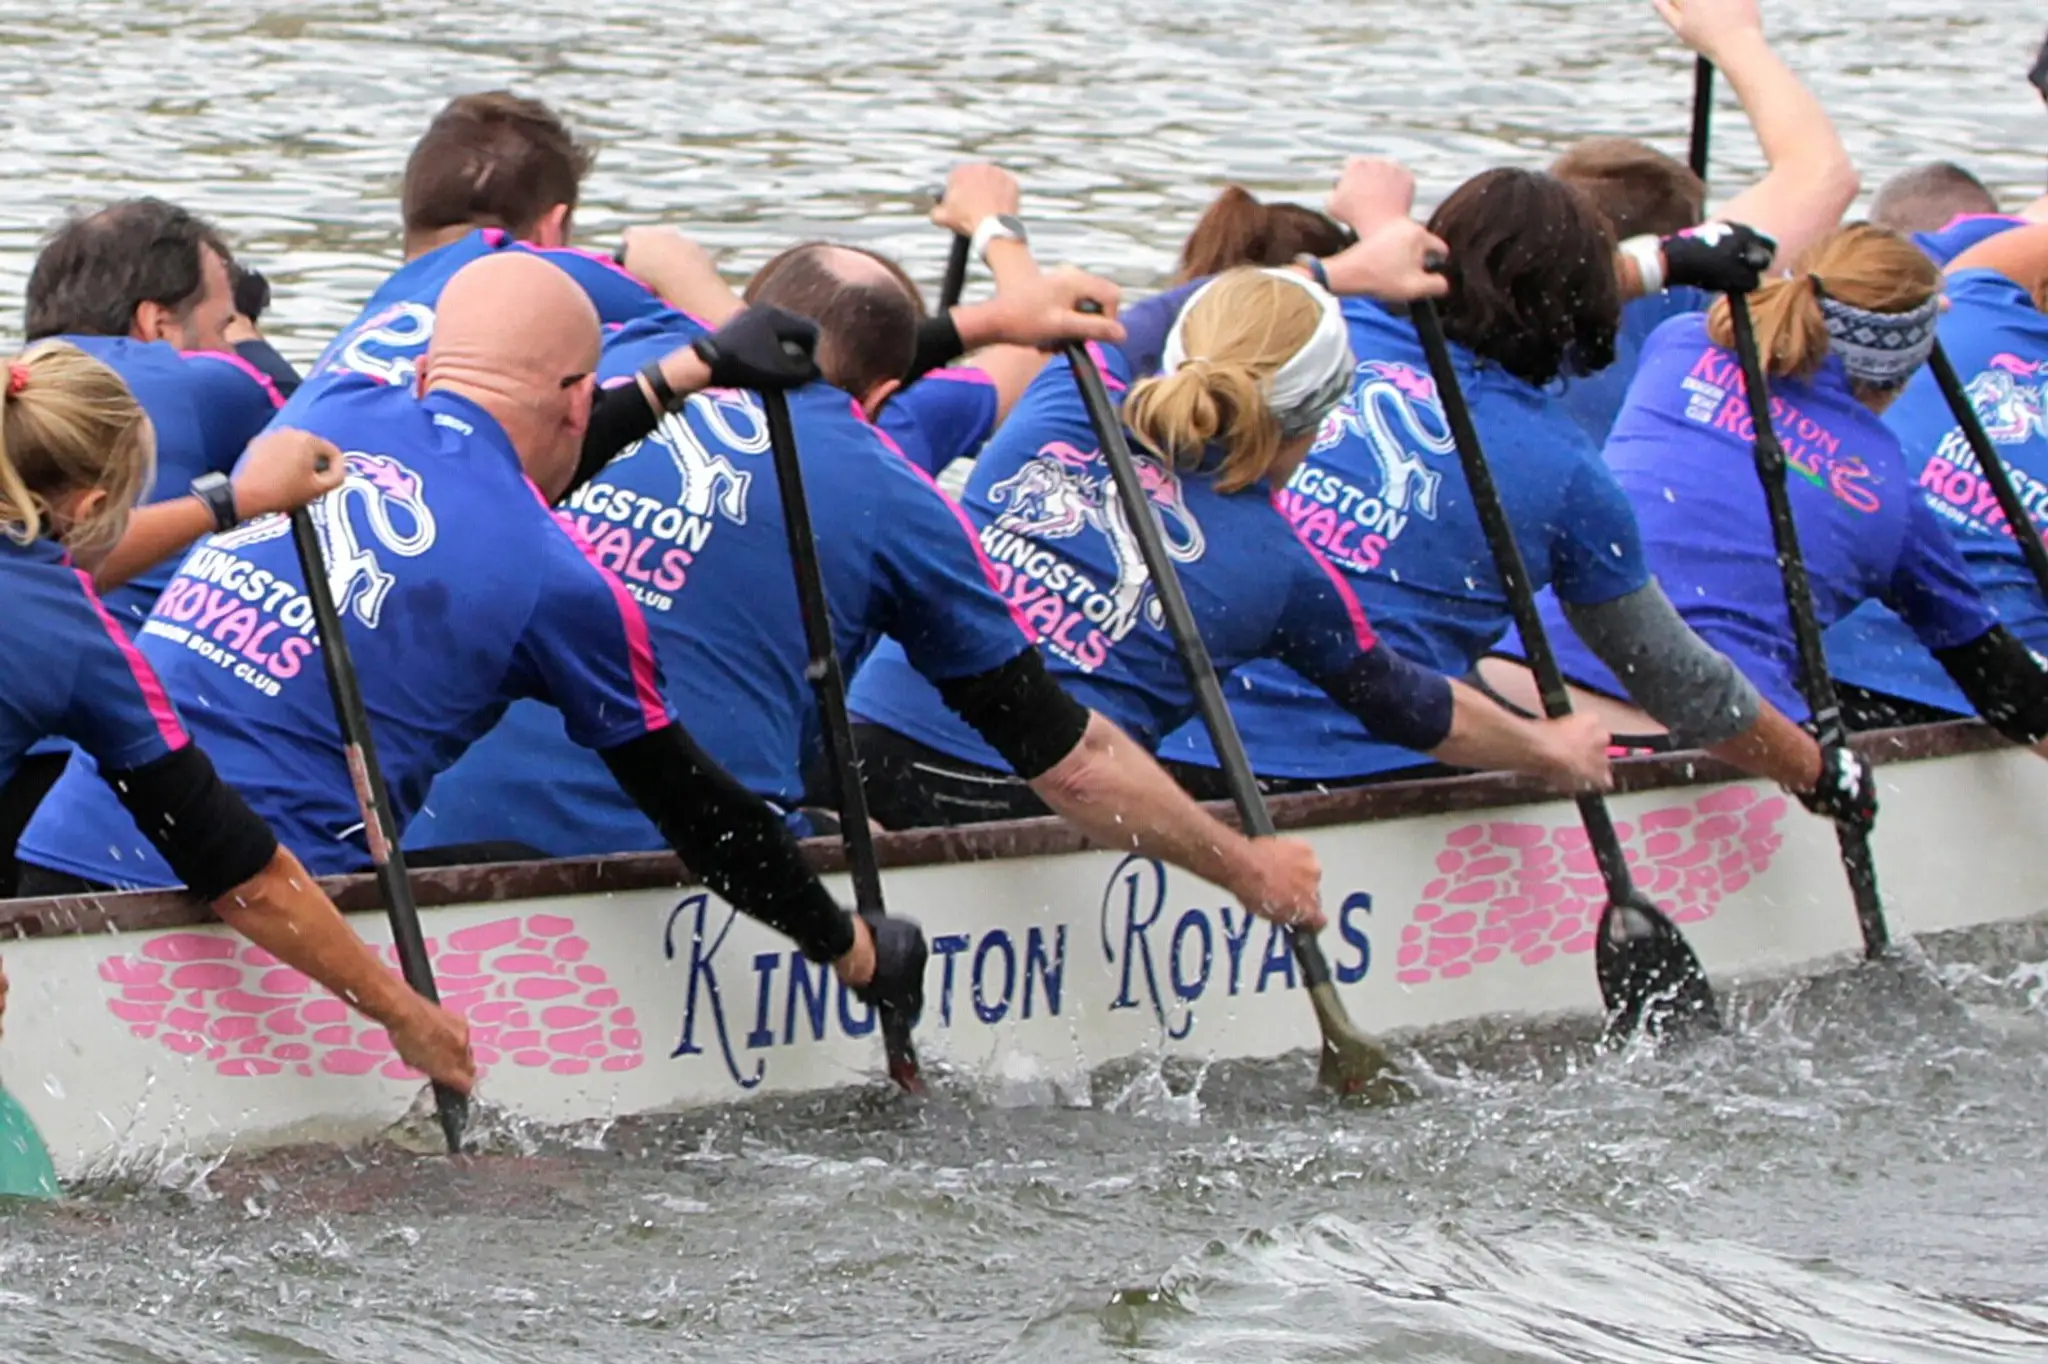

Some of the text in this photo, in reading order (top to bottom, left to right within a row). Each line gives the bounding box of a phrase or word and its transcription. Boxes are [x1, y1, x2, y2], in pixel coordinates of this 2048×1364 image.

[1690, 347, 1841, 457] KINSTON
[556, 511, 694, 591] YALS
[558, 480, 713, 552] NGSTON
[1287, 462, 1408, 541] GSTON
[152, 577, 313, 679] ROYALS
[980, 525, 1137, 641] KINGSTON
[994, 563, 1114, 669] OYALS
[233, 663, 282, 697] CLUB
[664, 853, 1373, 1089] KINGTON ROYAS
